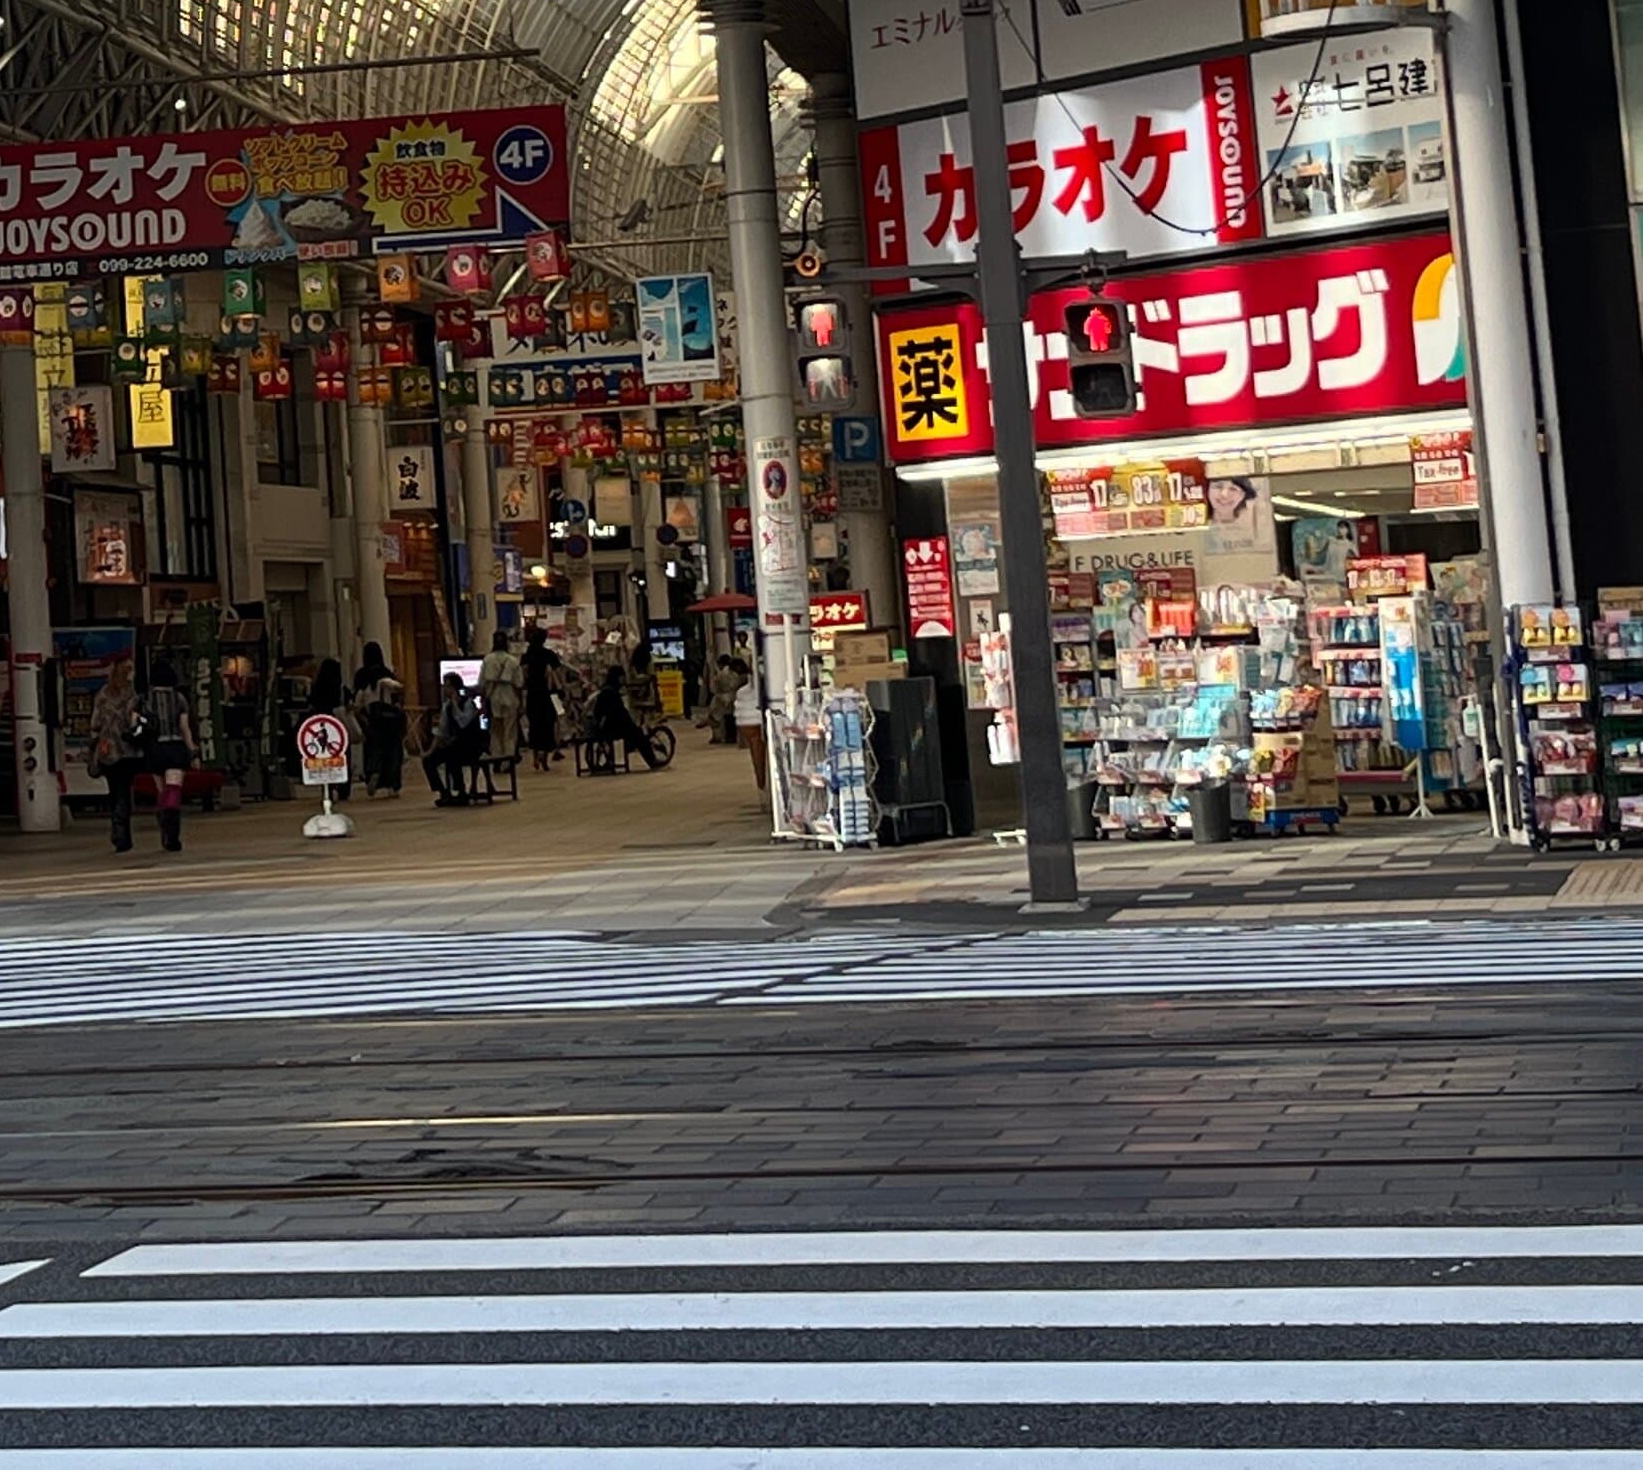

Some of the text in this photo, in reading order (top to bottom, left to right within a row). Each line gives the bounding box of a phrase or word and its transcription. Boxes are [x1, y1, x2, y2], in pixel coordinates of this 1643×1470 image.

[1332, 57, 1430, 112] 七呂建
[498, 138, 546, 170] 4F
[1213, 75, 1248, 229] JOYSOUND
[376, 160, 476, 201] 持込み
[923, 115, 1187, 248] カラオケ
[404, 198, 452, 227] OK
[98, 251, 210, 274] 099-224-6600
[896, 336, 960, 433] 薬
[842, 420, 871, 460] P
[809, 602, 861, 623] ラオケ
